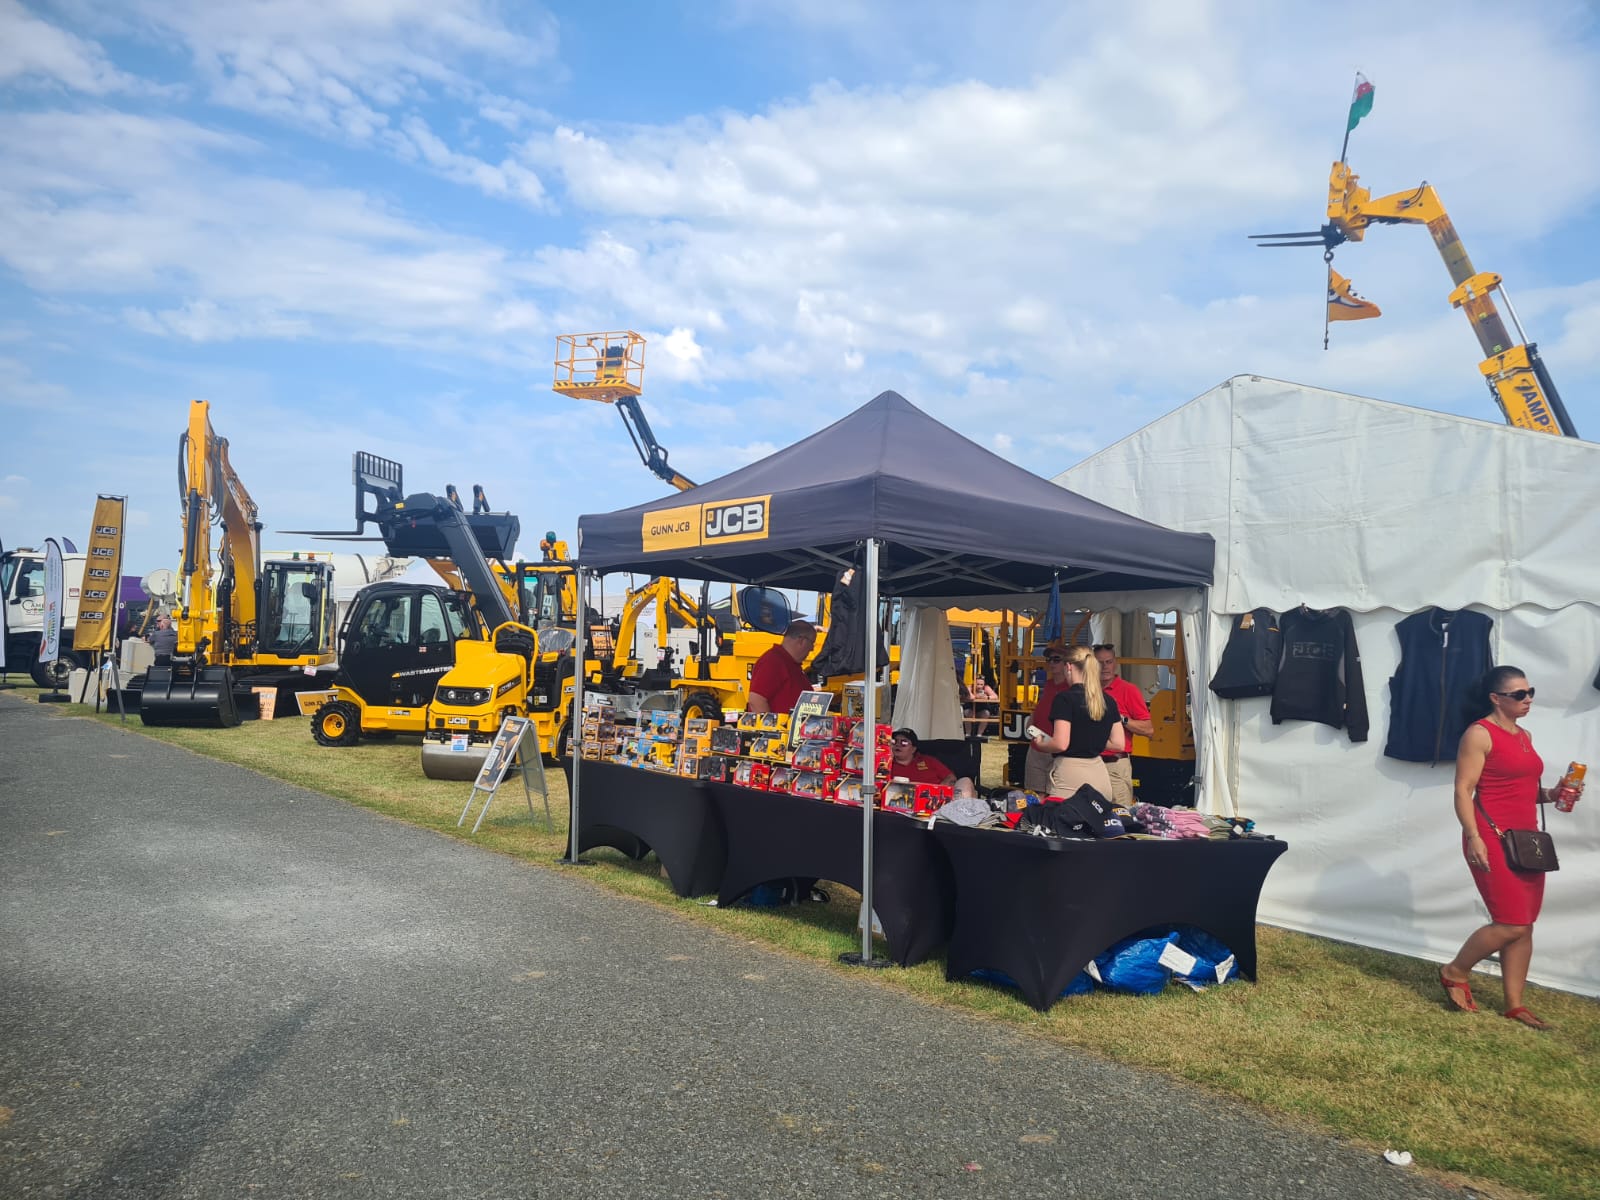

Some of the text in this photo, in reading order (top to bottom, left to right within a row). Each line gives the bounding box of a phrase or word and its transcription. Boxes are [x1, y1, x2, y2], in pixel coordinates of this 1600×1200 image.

[706, 503, 763, 536] JCB
[96, 526, 117, 535] JCB
[650, 521, 690, 536] GUNN JCB
[92, 548, 114, 556] JCB
[88, 569, 110, 577] JCB
[84, 590, 107, 598] JCB
